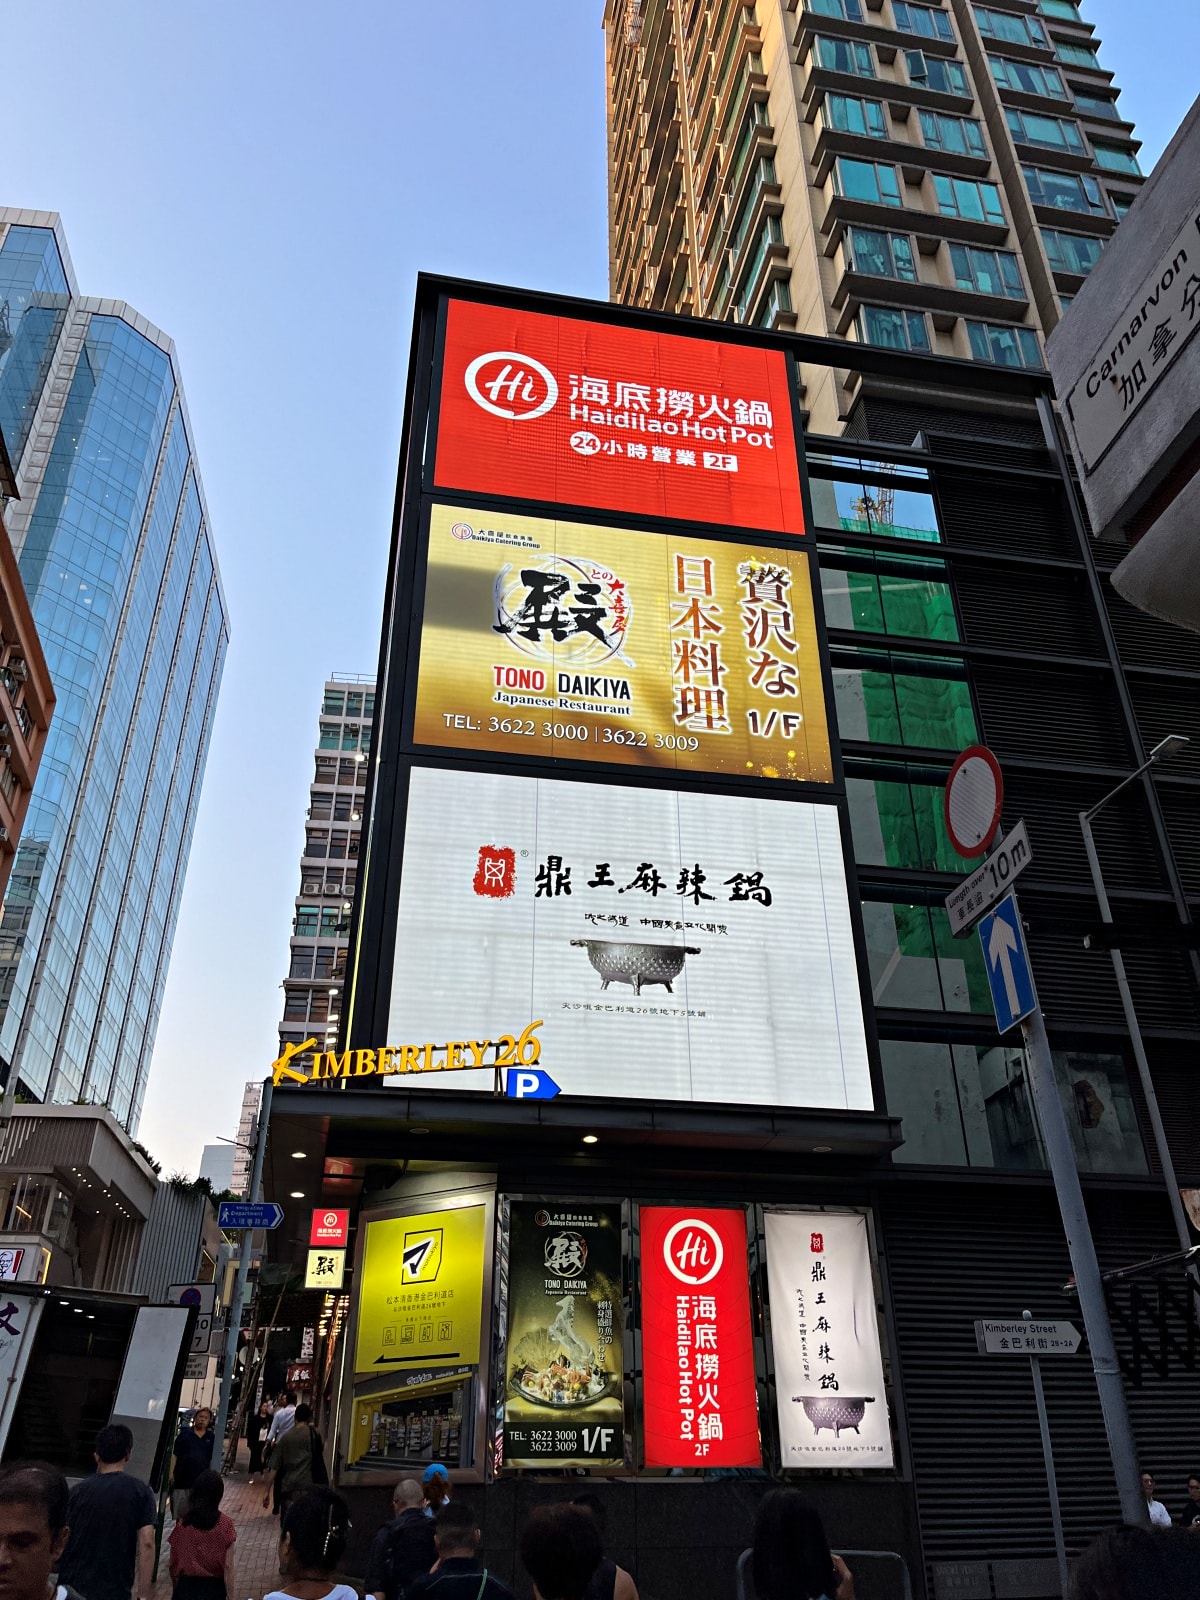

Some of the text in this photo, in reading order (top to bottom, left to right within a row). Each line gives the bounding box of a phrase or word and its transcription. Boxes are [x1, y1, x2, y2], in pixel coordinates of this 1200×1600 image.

[1085, 248, 1189, 399] Carnarvon
[568, 373, 774, 430] 海底撈火鍋
[731, 425, 774, 450] Pot
[522, 541, 541, 549] Group
[671, 554, 731, 733] 日本料理
[738, 564, 798, 697] 贅沢な
[493, 666, 631, 701] TONO DAIKIYA
[494, 691, 631, 715] Japanese Restaurant
[442, 713, 700, 752] TEL: 3622 3000 3622 3009
[749, 711, 800, 737] 1/F
[534, 854, 773, 907] 鼎王麻辣鍋
[272, 1019, 544, 1087] KIMBERLEY 26
[516, 1073, 540, 1098] P
[545, 1279, 588, 1289] TONO DAIKIYA
[811, 1261, 840, 1391] 鼎王麻辣鍋
[984, 1323, 1057, 1335] Kimberley Street
[999, 1337, 1048, 1349] 金巴利街
[676, 1295, 695, 1441] Haidilao Hot Pot
[692, 1295, 723, 1441] 海底撈火鍋
[509, 1430, 577, 1441] TEL: 3622 3000
[530, 1441, 577, 1452] 3622 3009
[581, 1426, 615, 1454] 1/F
[694, 1443, 710, 1456] 2F
